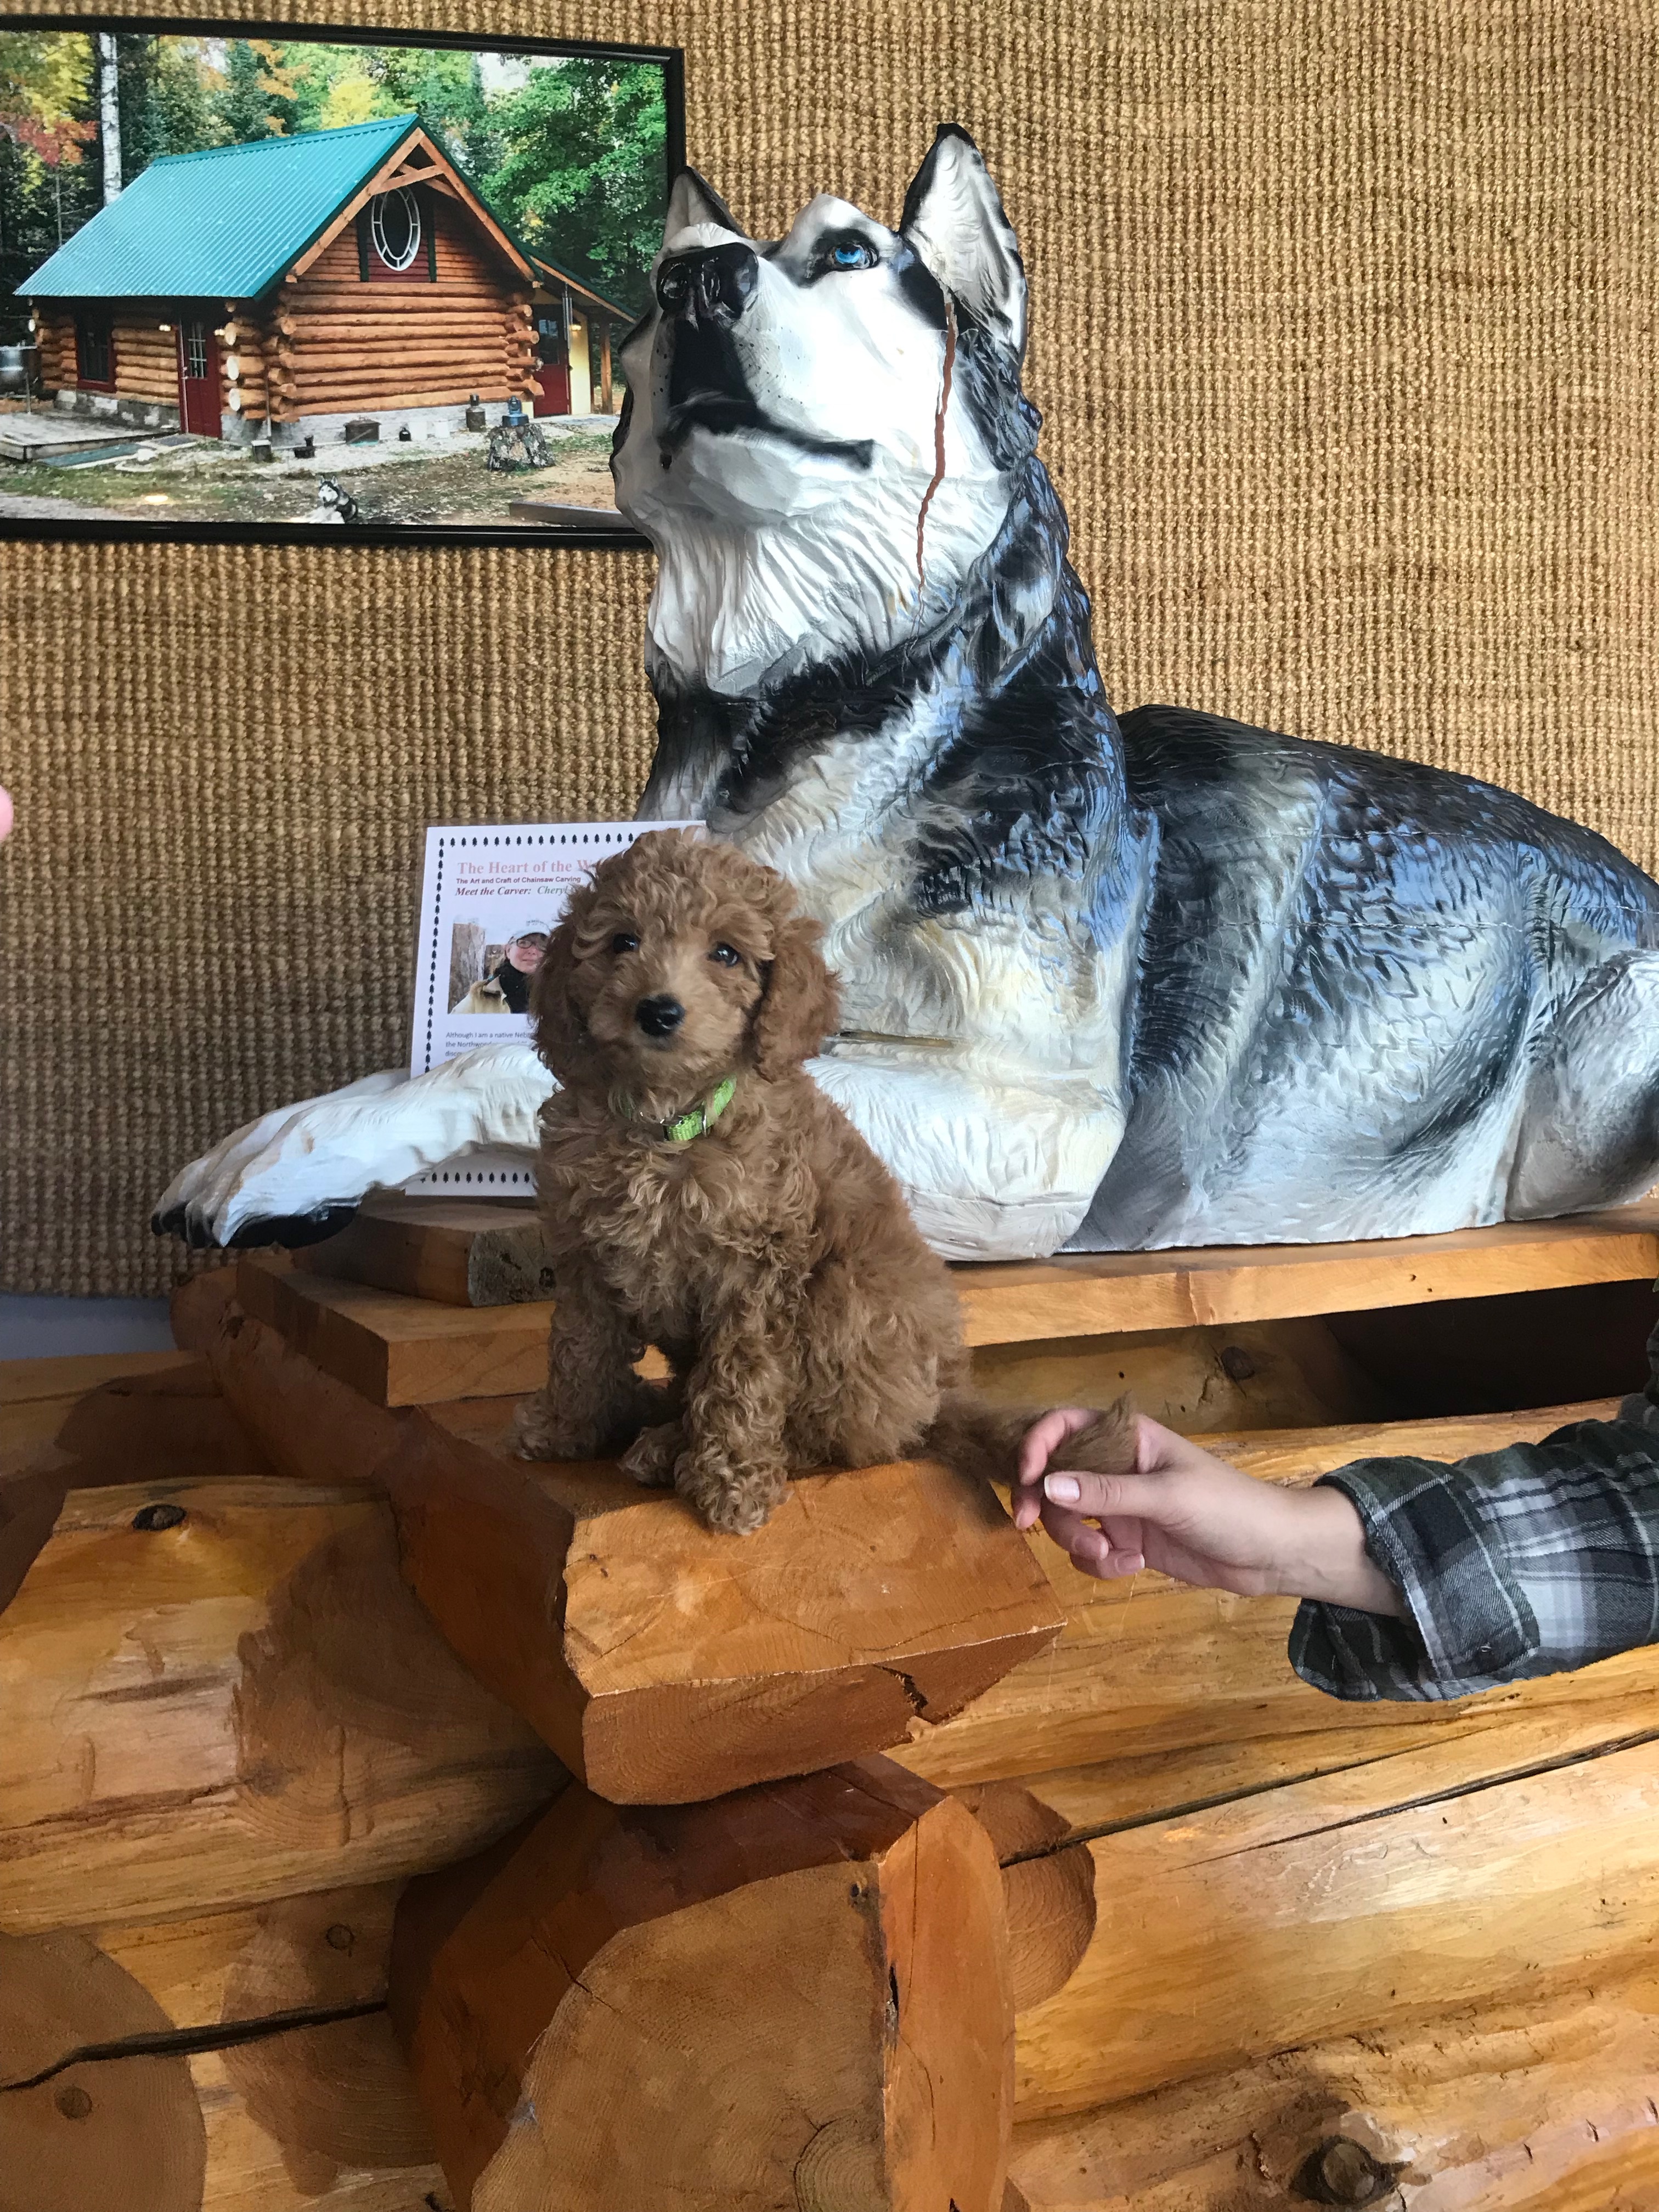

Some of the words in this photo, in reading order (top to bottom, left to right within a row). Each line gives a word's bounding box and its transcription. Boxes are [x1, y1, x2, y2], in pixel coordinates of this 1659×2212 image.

[457, 862, 484, 874] The
[489, 861, 528, 874] Heart
[533, 860, 548, 873] of
[551, 860, 572, 872] the
[455, 887, 478, 896] Meet
[480, 887, 494, 895] the
[497, 886, 531, 895] Carver:
